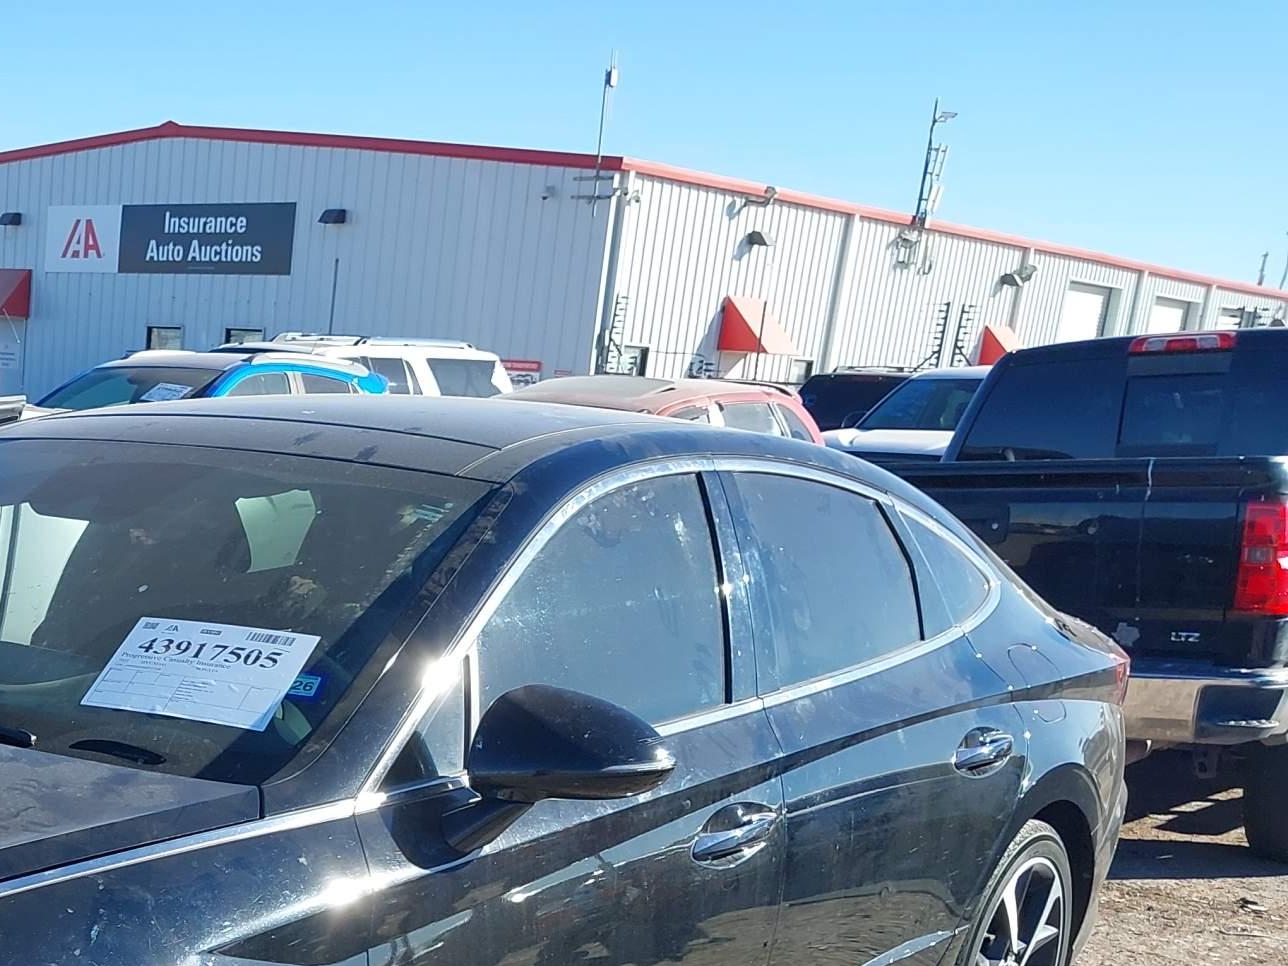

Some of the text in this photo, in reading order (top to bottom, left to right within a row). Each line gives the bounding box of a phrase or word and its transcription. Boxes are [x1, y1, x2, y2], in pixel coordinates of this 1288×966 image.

[164, 211, 246, 234] Insurance
[145, 239, 262, 262] Auto Auctions
[1170, 631, 1201, 642] LTZ
[138, 637, 283, 669] 43917505
[196, 659, 232, 670] Insurance
[289, 680, 315, 692] 26
